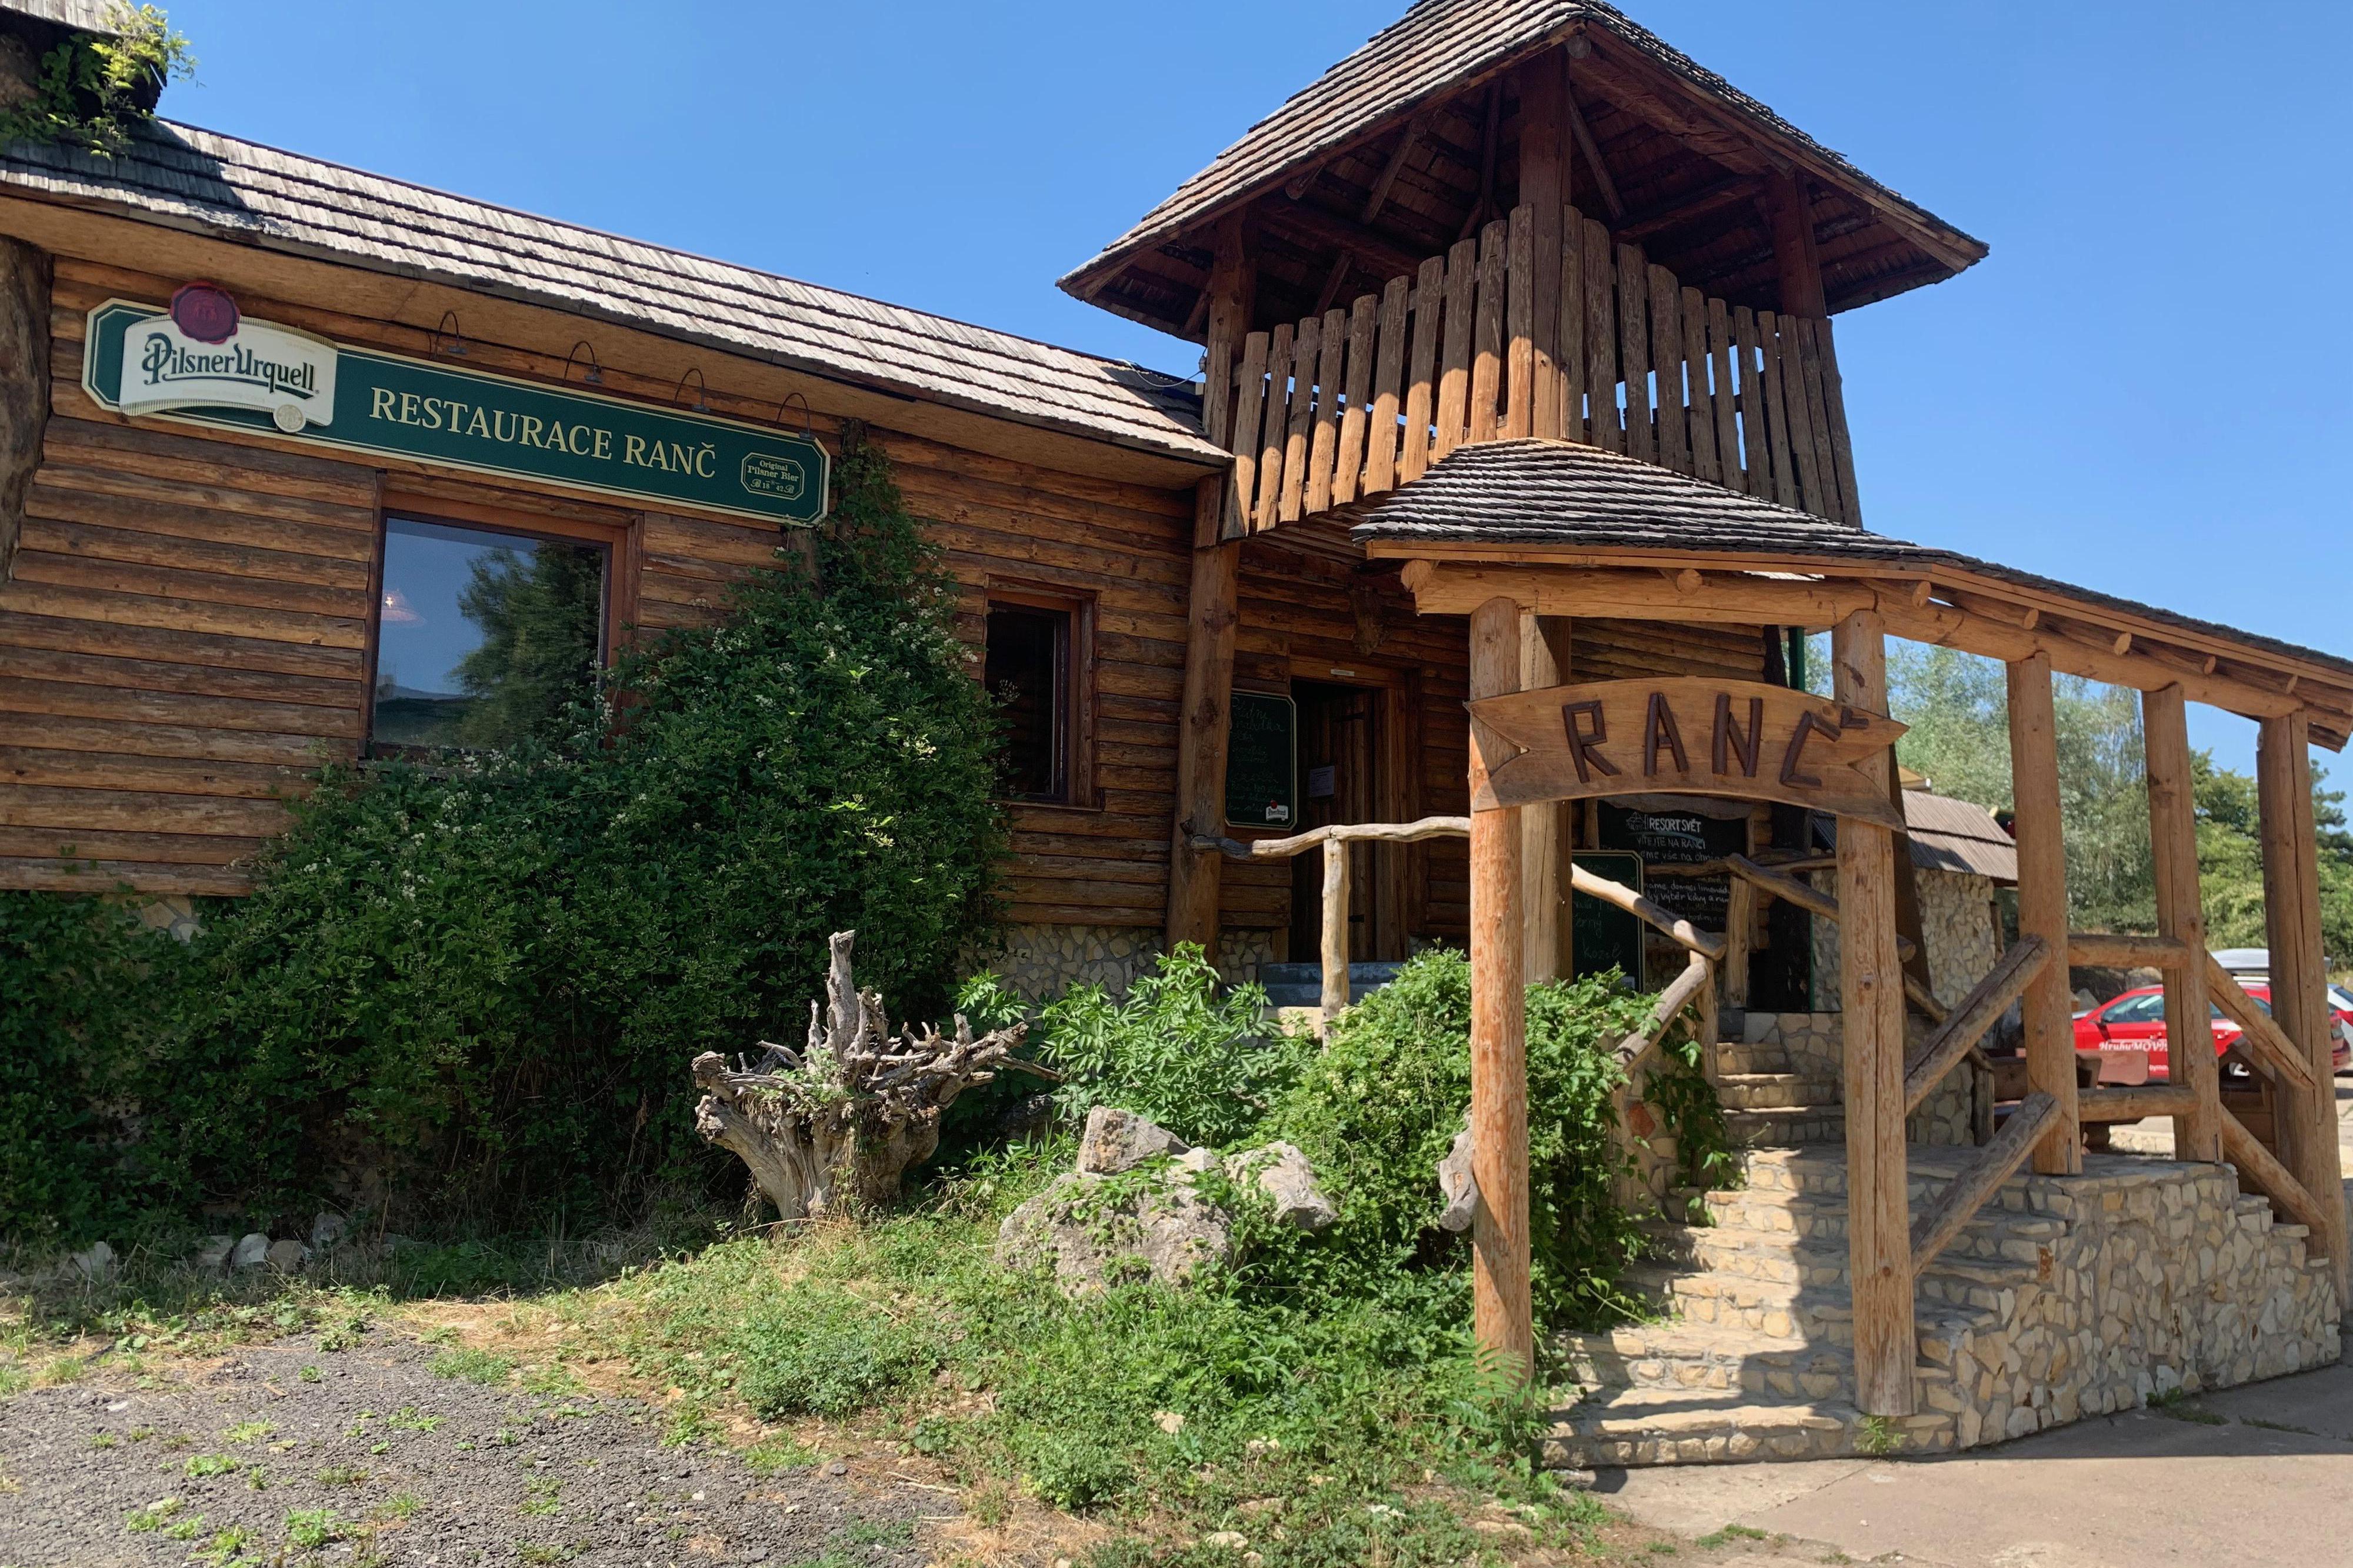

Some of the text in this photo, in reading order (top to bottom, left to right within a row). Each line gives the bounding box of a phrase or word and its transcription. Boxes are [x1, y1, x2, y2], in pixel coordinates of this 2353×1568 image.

[142, 332, 314, 393] Pilsner Urquell
[369, 386, 716, 479] RESTAURACE RANČ
[759, 460, 788, 471] Original
[747, 465, 799, 482] Pilsner Bier
[1562, 692, 1869, 791] RANČ
[1649, 818, 1680, 831] RESORT
[1668, 839, 1679, 848] NA
[1681, 853, 1692, 861] na
